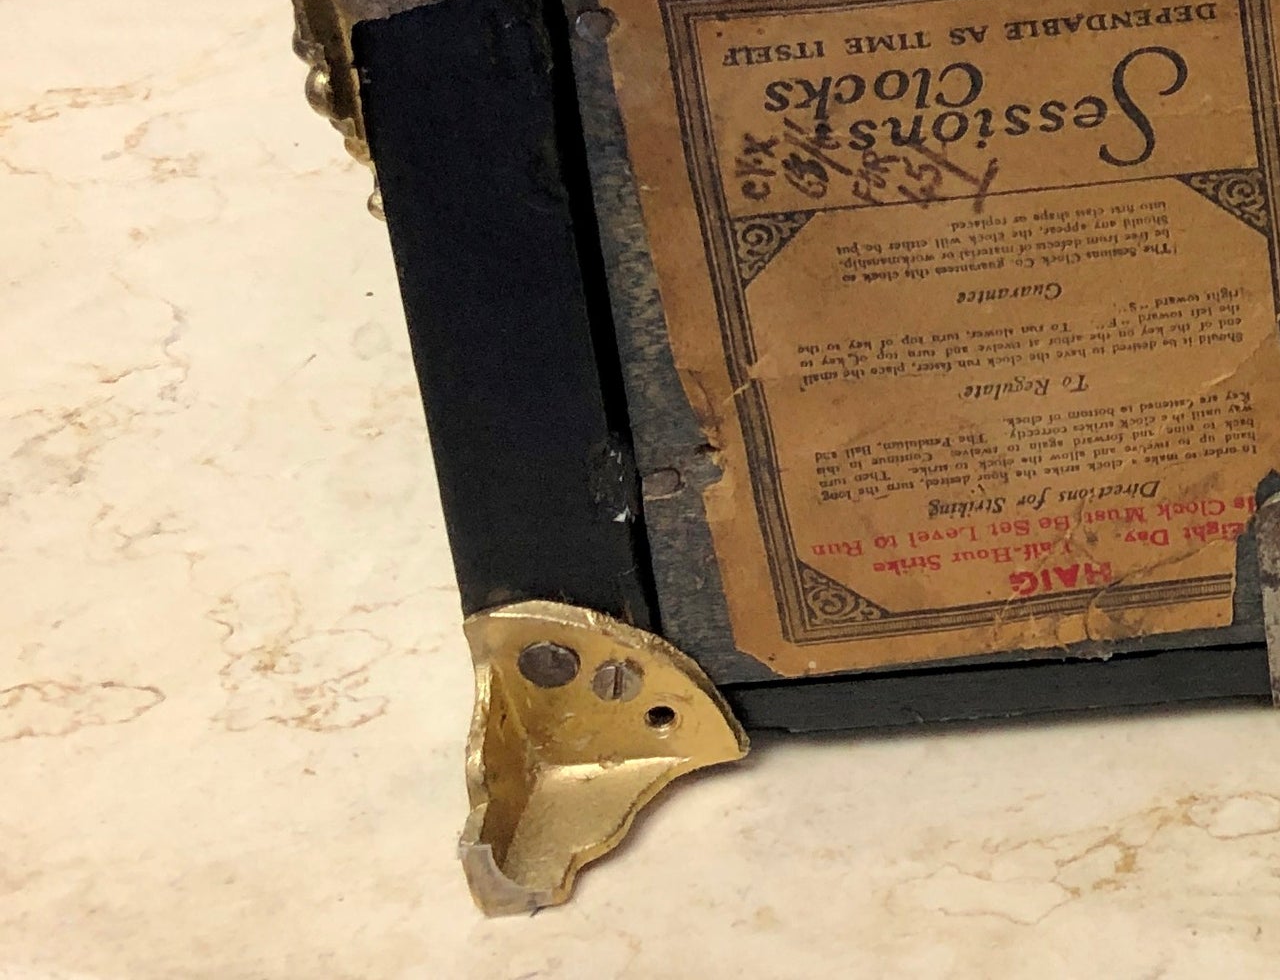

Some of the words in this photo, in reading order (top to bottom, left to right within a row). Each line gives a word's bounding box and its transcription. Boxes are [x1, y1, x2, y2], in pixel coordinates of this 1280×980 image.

[1004, 3, 1216, 40] DEPENDABLE
[949, 25, 989, 46] AS
[845, 31, 931, 55] TIME
[722, 40, 825, 67] ITSELF
[764, 62, 983, 120] Clocks
[848, 47, 1188, 167] Sessions
[1075, 207, 1104, 218] class
[1111, 204, 1134, 214] first
[1139, 201, 1166, 211] into
[1033, 208, 1069, 222] shape
[1094, 220, 1116, 229] any
[1123, 214, 1168, 230] Should
[968, 231, 1004, 246] clock
[1012, 229, 1032, 240] the
[1086, 233, 1118, 244] from
[1124, 231, 1148, 243] free
[1154, 228, 1169, 238] be
[888, 239, 927, 252] either
[934, 237, 961, 248] will
[1018, 243, 1032, 255] of
[1035, 238, 1081, 252] defects
[1143, 242, 1171, 254] The
[959, 245, 1013, 260] material
[1085, 246, 1136, 258] Sessions
[1040, 252, 1081, 266] Clock
[934, 257, 1004, 275] guarantees
[861, 271, 899, 283] clock
[904, 268, 929, 279] this
[956, 282, 1062, 304] Guarantee
[1206, 287, 1238, 302] right
[1154, 294, 1199, 308] toward
[1190, 306, 1212, 318] left
[1219, 303, 1239, 315] the
[1138, 310, 1182, 324] toward
[1218, 317, 1241, 329] end
[1050, 322, 1071, 332] To
[1118, 328, 1134, 337] on
[1139, 323, 1163, 336] key
[1170, 322, 1190, 333] the
[1198, 321, 1212, 332] of
[1048, 334, 1083, 345] arbor
[1089, 332, 1110, 342] the
[1162, 338, 1177, 347] be
[1198, 331, 1243, 345] Should
[880, 339, 893, 351] of
[945, 345, 968, 358] and
[977, 341, 1020, 352] twelve
[1112, 340, 1156, 354] desired
[1029, 352, 1049, 363] the
[1056, 348, 1086, 358] have
[821, 354, 845, 368] key
[956, 358, 980, 368] run
[987, 354, 1022, 367] clock
[843, 368, 865, 381] the
[870, 361, 905, 376] place
[802, 371, 838, 386] small
[1062, 374, 1088, 393] To
[963, 376, 1049, 400] Regulate
[1048, 413, 1061, 424] of
[1067, 407, 1114, 419] bottom
[1073, 420, 1113, 433] strikes
[1119, 416, 1155, 429] clock
[1202, 421, 1215, 429] to
[1224, 417, 1254, 430] back
[958, 433, 987, 445] The
[1073, 432, 1123, 448] forward
[1199, 433, 1215, 443] up
[1224, 431, 1255, 444] hand
[1007, 444, 1019, 452] to
[1029, 437, 1063, 452] again
[871, 452, 932, 465] Continue
[1049, 450, 1085, 461] allow
[1093, 447, 1115, 459] and
[1203, 446, 1237, 458] order
[849, 460, 862, 469] in
[1021, 455, 1042, 465] the
[1086, 459, 1123, 471] clock
[1144, 453, 1178, 465] make
[854, 470, 891, 482] Then
[1015, 469, 1036, 479] the
[1044, 464, 1080, 476] strike
[820, 489, 851, 501] long
[858, 485, 879, 495] the
[1058, 480, 1160, 505] Directions
[1016, 486, 1051, 510] for
[928, 496, 1006, 519] Striking
[1156, 499, 1225, 521] Clock
[1083, 506, 1147, 524] Must
[990, 519, 1030, 536] Set
[1038, 515, 1070, 532] Be
[908, 525, 978, 548] Level
[1183, 521, 1245, 543] Eight
[811, 539, 863, 556] Run
[874, 535, 897, 548] to
[873, 554, 941, 575] Strike
[1009, 563, 1113, 596] HAIG
